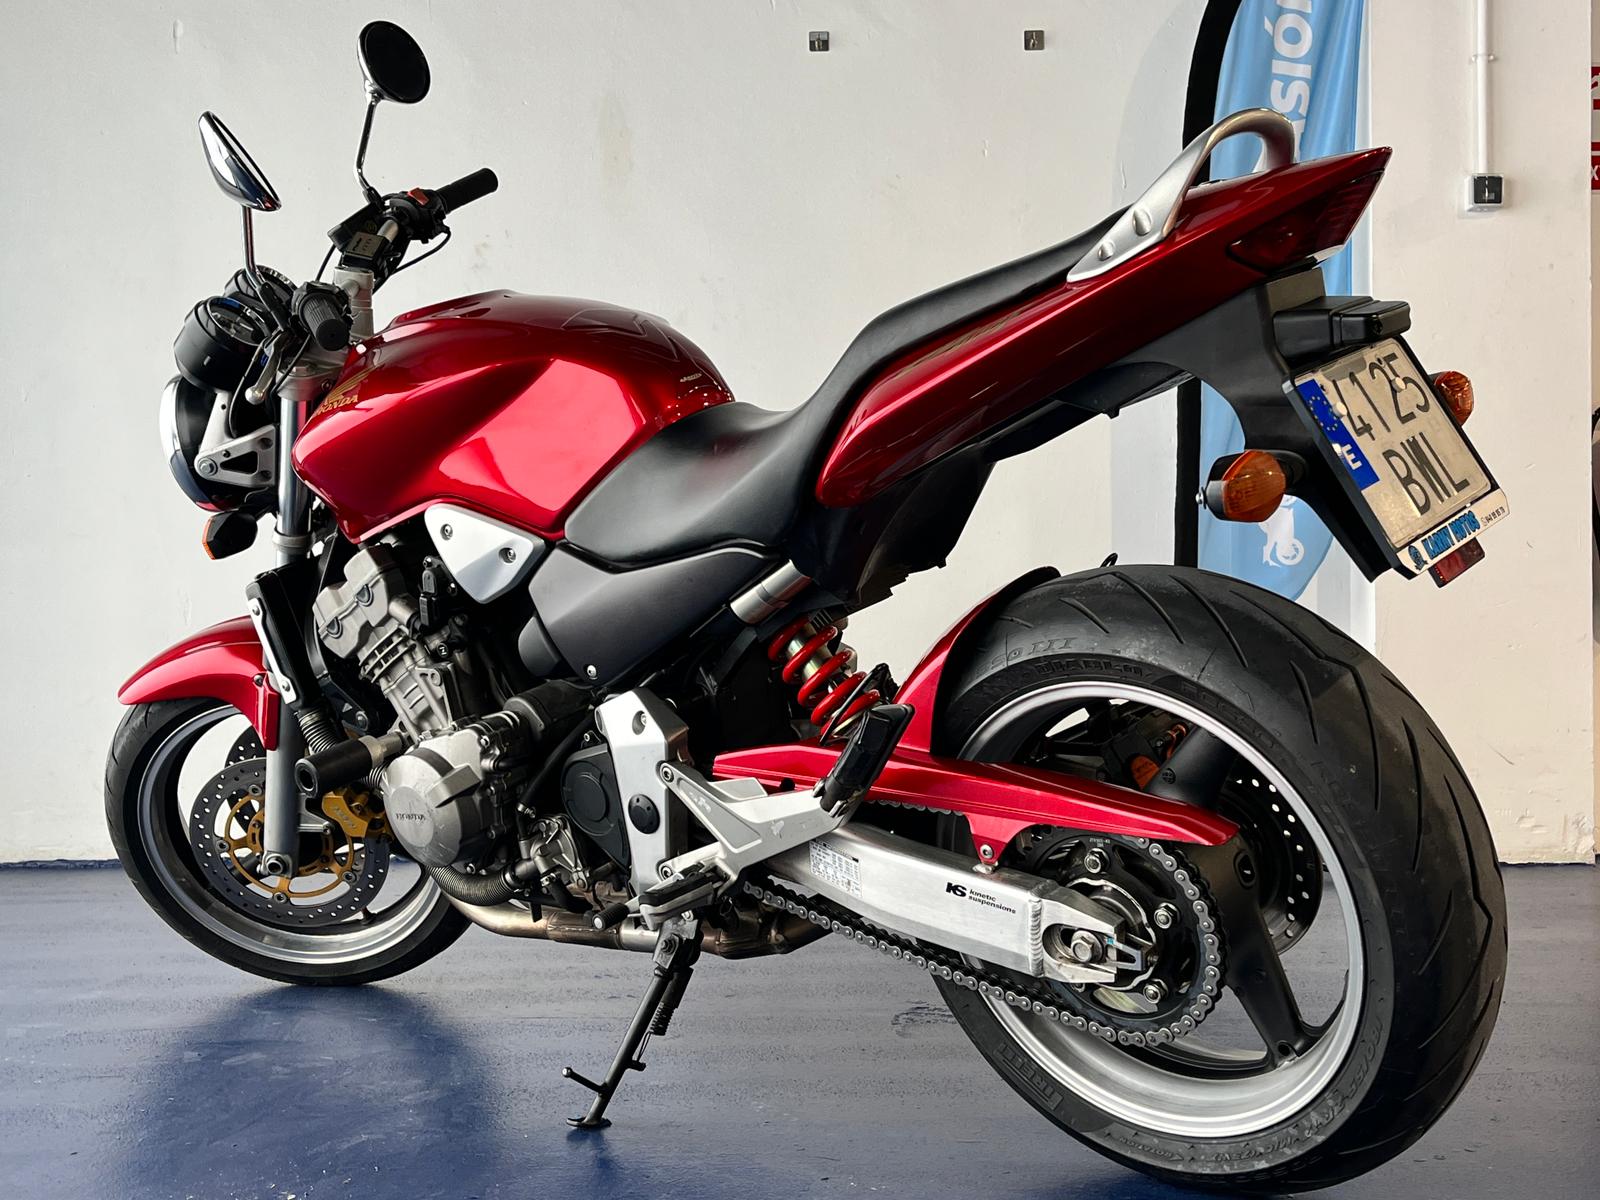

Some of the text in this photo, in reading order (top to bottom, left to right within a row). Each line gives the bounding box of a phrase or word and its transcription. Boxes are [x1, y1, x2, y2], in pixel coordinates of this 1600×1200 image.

[317, 395, 358, 415] HONDA
[1332, 352, 1431, 441] 4125
[1342, 443, 1363, 470] E
[1382, 432, 1471, 515] BWL
[945, 881, 997, 903] KS kinetic
[968, 895, 1017, 914] suspensions
